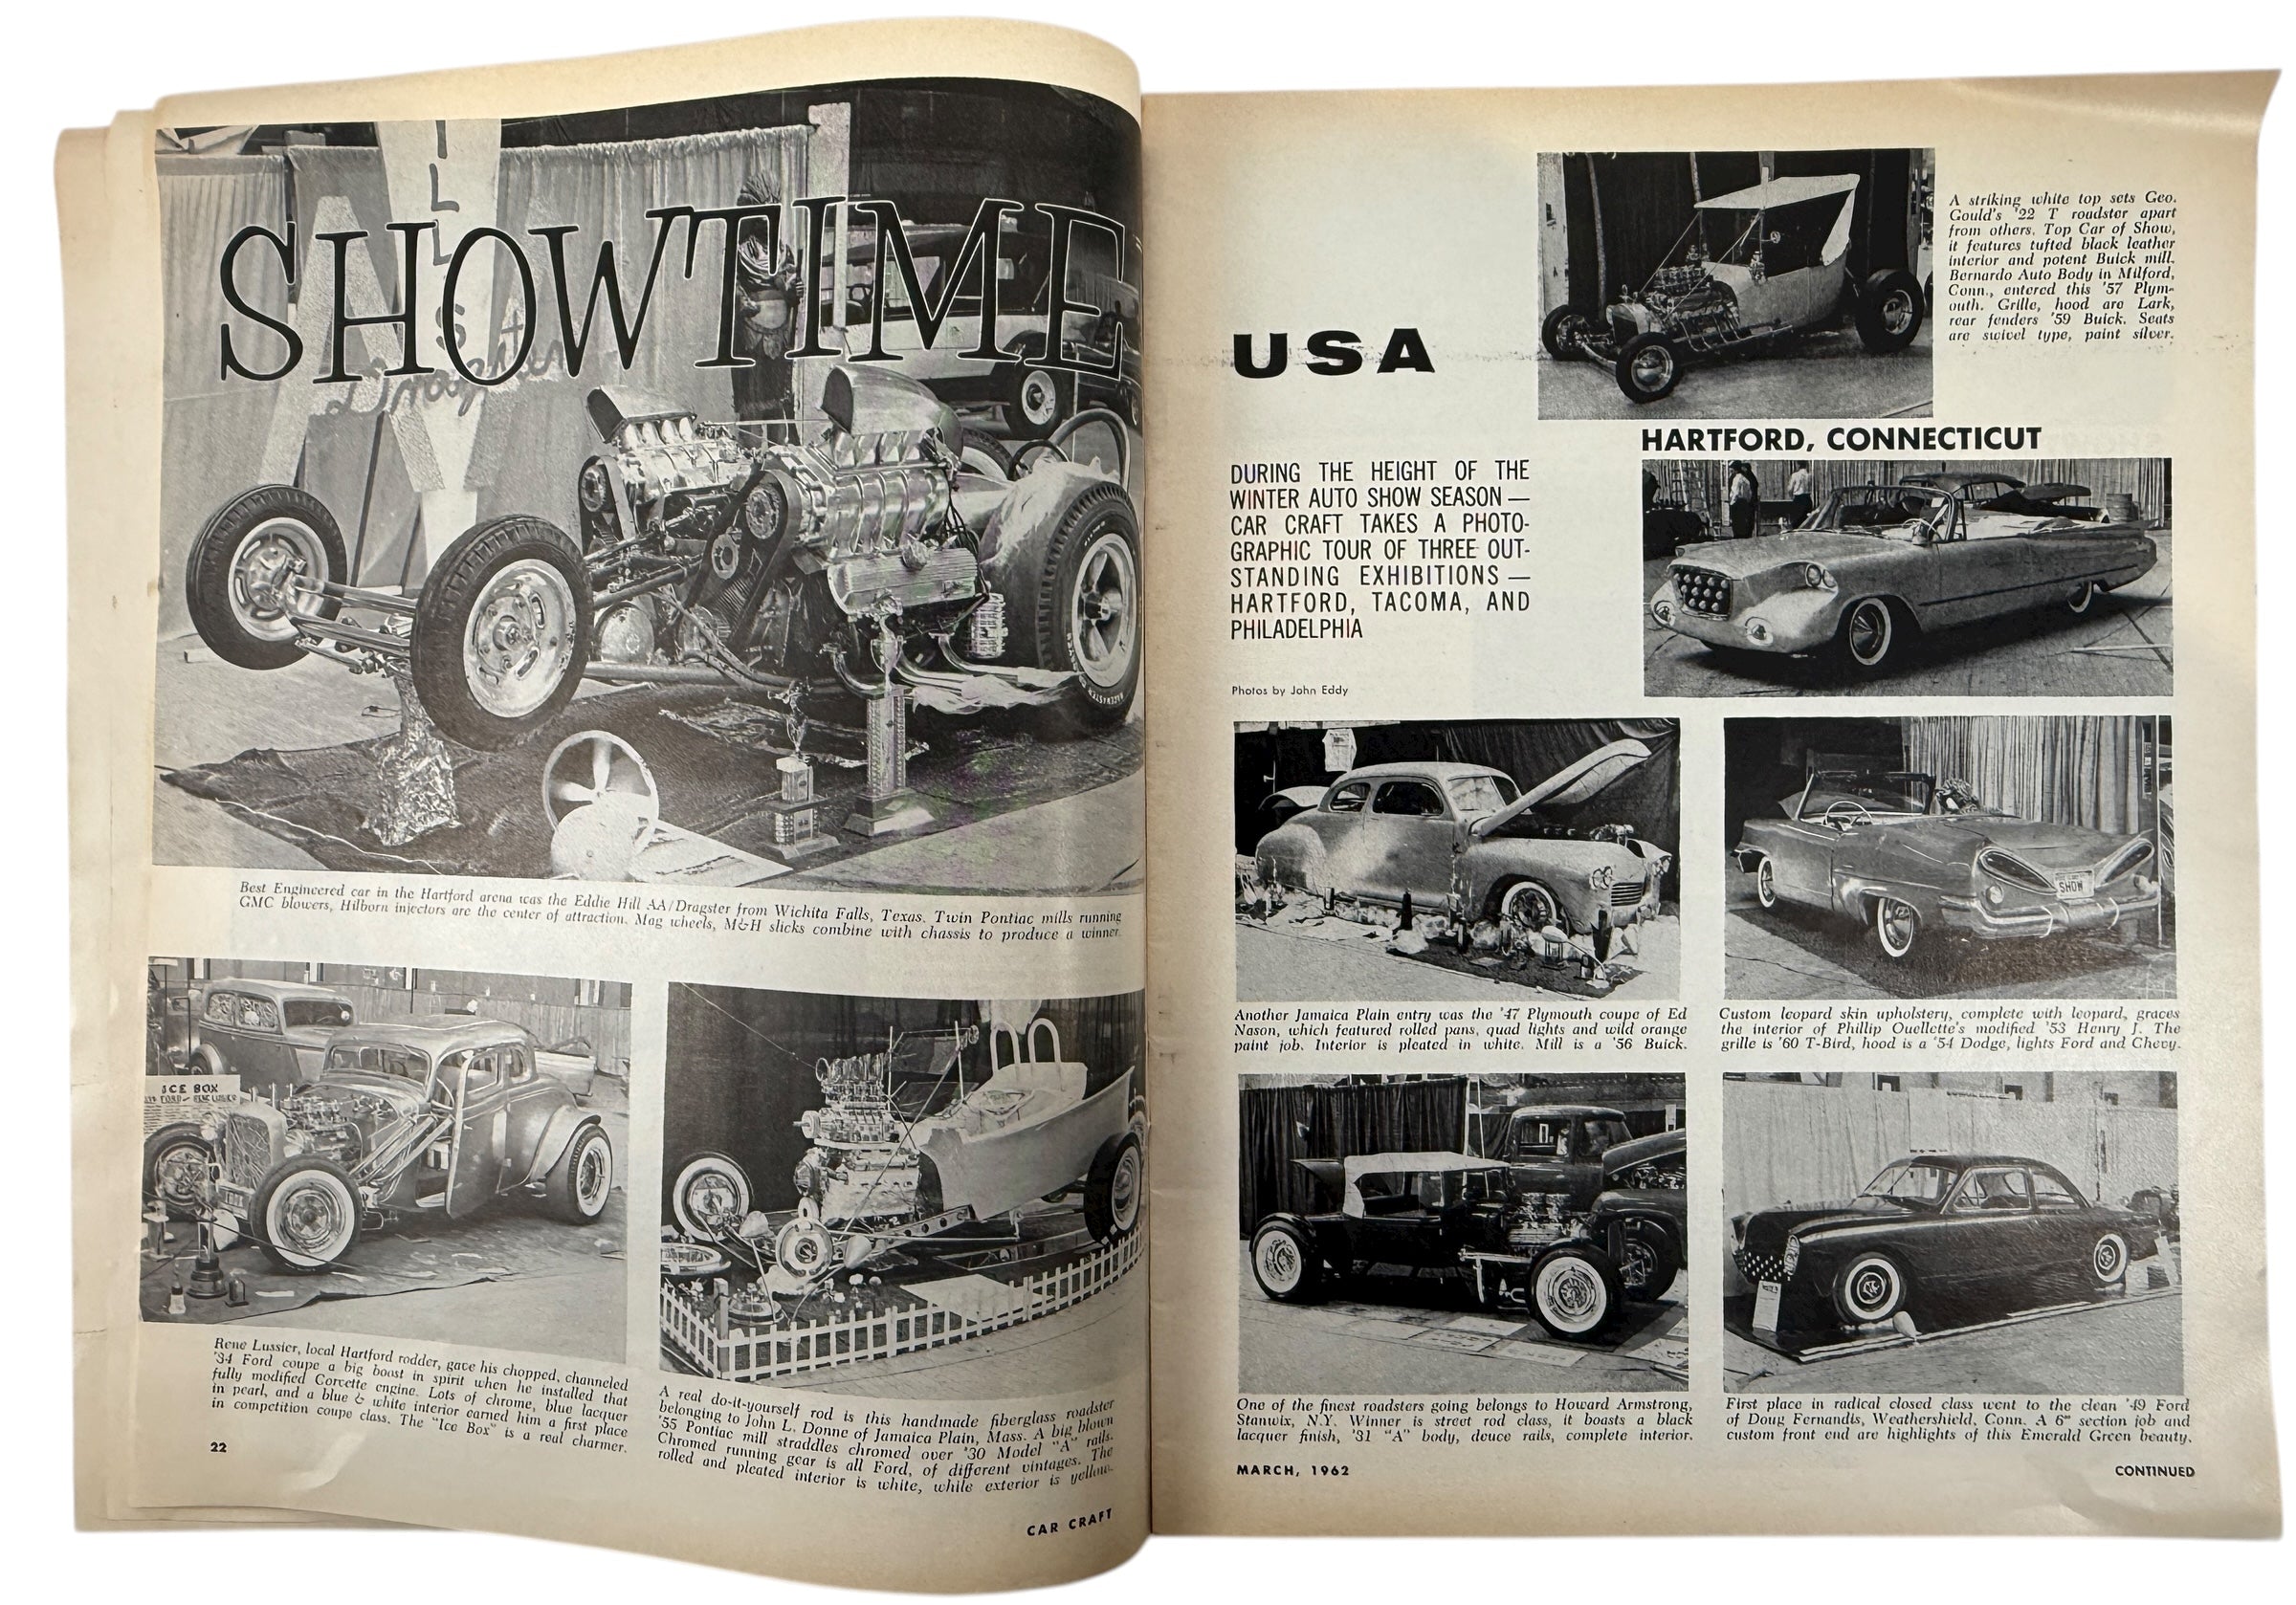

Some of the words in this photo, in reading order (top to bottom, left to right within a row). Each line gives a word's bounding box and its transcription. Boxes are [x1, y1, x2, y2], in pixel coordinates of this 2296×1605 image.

[1950, 194, 1959, 206] A
[1969, 193, 2020, 208] striking
[2032, 191, 2069, 205] white
[2079, 194, 2101, 207] top
[2110, 193, 2135, 203] sets
[2146, 191, 2176, 203] Geo.
[1950, 208, 2001, 221] Gould's
[2015, 207, 2035, 220] '22
[2048, 208, 2059, 219] T
[2072, 207, 2128, 219] roadster
[2140, 208, 2176, 221] apart
[1949, 224, 1980, 238] from
[1990, 223, 2035, 236] others.
[2044, 223, 2071, 237] Top
[2079, 222, 2105, 234] Car
[2112, 222, 2127, 236] of
[2134, 221, 2175, 234] Show,
[220, 195, 1125, 385] SHOWTIME
[1233, 328, 1435, 378] USA
[1643, 429, 1814, 451] HARTFORD,
[1827, 427, 2042, 451] CONNECTICUT
[1231, 463, 1300, 484] DURING
[1319, 462, 1353, 481] THE
[1372, 461, 1437, 481] HEIGHT
[1455, 460, 1477, 480] OF
[1495, 459, 1529, 480] THE
[1230, 489, 1299, 510] WINTER
[1309, 488, 1357, 508] AUTO
[1368, 487, 1421, 507] SHOW
[1431, 486, 1501, 507] SEASON
[1231, 516, 1266, 536] CAR
[1286, 514, 1343, 535] CRAFT
[1360, 513, 1418, 533] TAKES
[1434, 513, 1446, 533] A
[1464, 513, 1529, 533] PHOTO-
[1231, 540, 1311, 561] GRAPHIC
[1323, 539, 1371, 560] TOUR
[1384, 539, 1406, 560] OF
[1418, 539, 1478, 559] THREE
[1488, 539, 1530, 559] OUT-
[1231, 566, 1338, 587] STANDING
[1360, 565, 1498, 585] EXHIBITIONS
[1231, 592, 1355, 615] HARTFORD,
[1372, 591, 1468, 614] TACOMA,
[1487, 591, 1529, 611] AND
[1231, 619, 1362, 640] PHILADELPHIA
[1232, 686, 1268, 694] Photos
[1272, 686, 1285, 696] by
[1291, 686, 1315, 694] John
[1322, 685, 1348, 696] Eddy
[2059, 880, 2083, 893] SHOW
[240, 882, 265, 892] Best
[275, 883, 344, 895] Engineered
[378, 888, 387, 897] in
[396, 887, 413, 898] the
[421, 889, 473, 902] Hartford
[549, 893, 566, 905] the
[575, 894, 609, 908] Eddie
[618, 897, 640, 910] Hill
[647, 899, 730, 914] AA/Dragster
[737, 903, 766, 917] from
[775, 905, 828, 918] Wichita
[836, 907, 872, 922] Falls,
[881, 910, 925, 923] Texas.
[935, 911, 971, 923] Twin
[981, 912, 1033, 924] Pontiac
[1042, 911, 1072, 924] mills
[1080, 912, 1121, 924] running
[1235, 1008, 1289, 1021] Another
[1295, 1009, 1348, 1022] Jamaica
[1357, 1008, 1389, 1021] Plain
[1397, 1010, 1431, 1022] entry
[1472, 1007, 1492, 1020] the
[1501, 1007, 1520, 1020] '47
[1527, 1007, 1592, 1022] Plymouth
[1600, 1011, 1639, 1022] coupe
[1646, 1008, 1660, 1022] of
[1668, 1007, 1687, 1020] Ed
[1719, 1008, 1771, 1020] Custom
[1781, 1006, 1832, 1022] leopard
[1841, 1006, 1867, 1019] skin
[1877, 1006, 1952, 1022] upholstery,
[1961, 1006, 2023, 1022] complete
[2033, 1006, 2062, 1019] with
[2072, 1006, 2127, 1022] leopard,
[2137, 1011, 2179, 1021] graces
[162, 1084, 187, 1094] ICE
[193, 1084, 218, 1093] BOX
[214, 1338, 247, 1350] Rene
[253, 1339, 300, 1355] Lussier,
[306, 1342, 335, 1356] local
[341, 1346, 393, 1362] Hartford
[399, 1353, 441, 1370] rodder,
[447, 1362, 475, 1372] gave
[480, 1360, 497, 1374] his
[503, 1364, 560, 1383] chopped,
[565, 1371, 628, 1391] channeled
[659, 1386, 669, 1396] A
[679, 1389, 702, 1402] real
[712, 1392, 800, 1418] do-it-yourself
[811, 1407, 833, 1420] rod
[844, 1411, 853, 1422] is
[866, 1411, 891, 1425] this
[902, 1413, 979, 1428] handmade
[990, 1411, 1056, 1428] fiberglass
[1067, 1400, 1115, 1419] roadster
[1237, 1398, 1265, 1410] One
[1271, 1398, 1285, 1413] of
[1292, 1398, 1314, 1411] the
[1319, 1398, 1355, 1415] finest
[1364, 1398, 1424, 1412] roadsters
[1431, 1400, 1468, 1414] going
[1476, 1397, 1527, 1414] belongs
[1535, 1400, 1547, 1411] to
[1556, 1396, 1609, 1410] Howard
[1617, 1398, 1692, 1414] Armstrong,
[1727, 1430, 1774, 1440] custom
[1783, 1427, 1816, 1441] front
[1825, 1427, 1849, 1440] end
[1888, 1426, 1955, 1442] highlights
[1965, 1428, 1978, 1442] of
[1987, 1427, 2011, 1440] this
[2021, 1428, 2081, 1441] Emerald
[2089, 1430, 2130, 1441] Green
[2140, 1428, 2191, 1445] beauty.
[210, 1441, 227, 1453] 22
[658, 1432, 717, 1452] Chromed
[727, 1446, 777, 1464] running
[786, 1456, 816, 1466] gear
[827, 1457, 836, 1469] is
[846, 1458, 863, 1472] all
[923, 1463, 938, 1479] of
[949, 1463, 1010, 1478] different
[1237, 1465, 1299, 1477] MARCH,
[1312, 1465, 1349, 1476] 1962
[2115, 1465, 2195, 1477] CONTINUED
[1027, 1523, 1058, 1536] CAR
[1069, 1508, 1112, 1529] CRAFT
